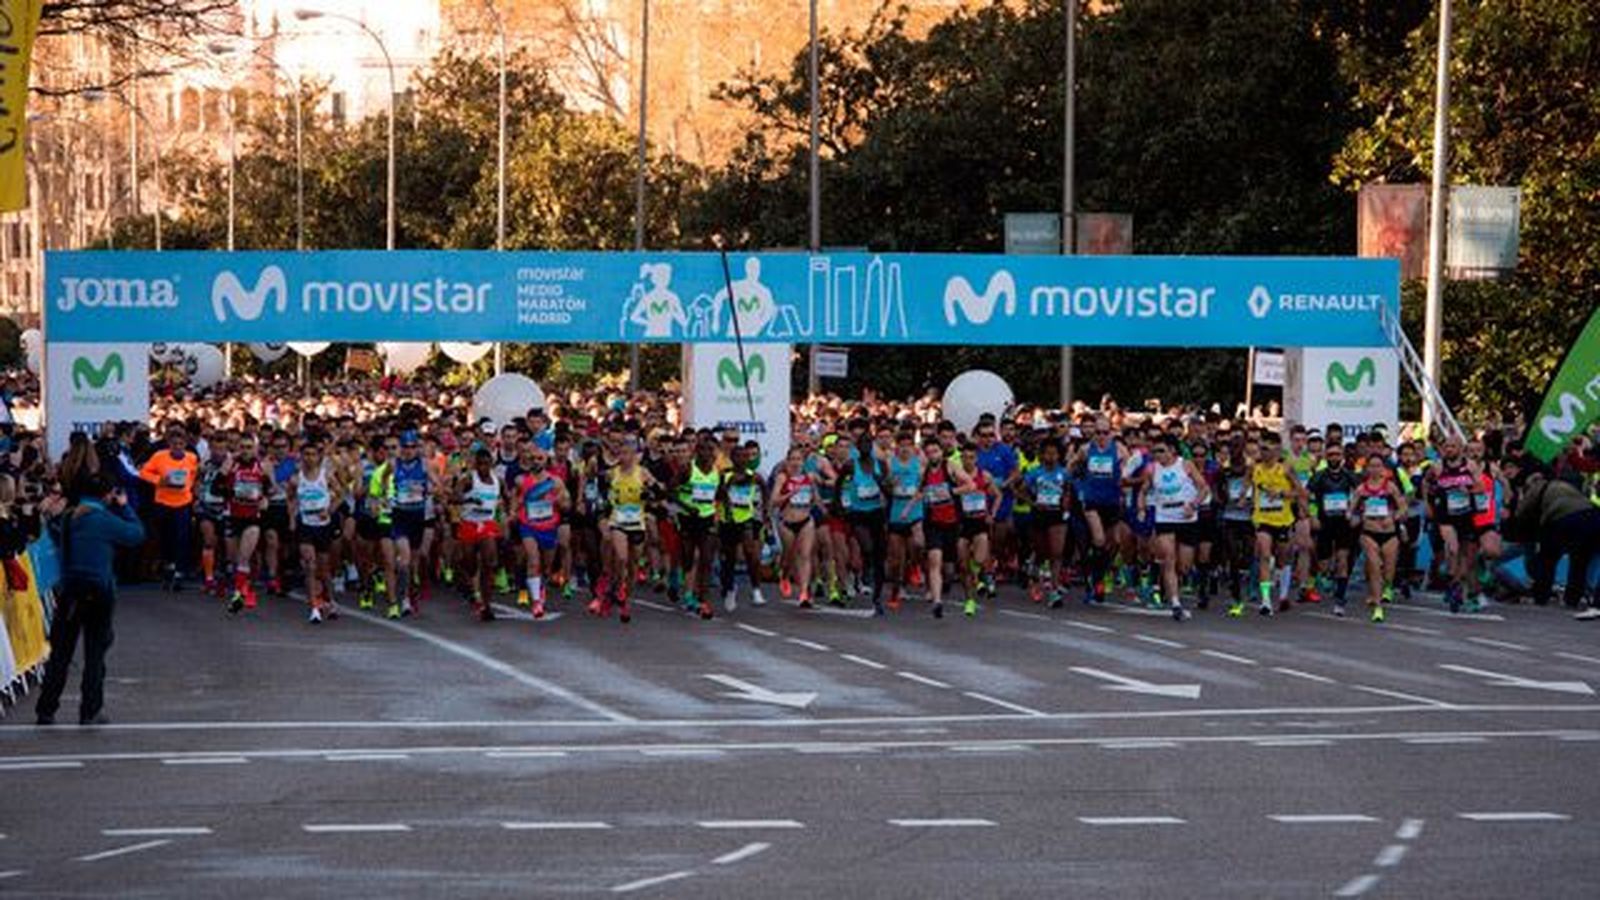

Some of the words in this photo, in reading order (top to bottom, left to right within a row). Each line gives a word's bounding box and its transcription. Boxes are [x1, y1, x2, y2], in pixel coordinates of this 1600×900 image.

[516, 267, 585, 281] movistar
[303, 278, 492, 313] movistar
[516, 284, 564, 296] MEDIO
[1030, 282, 1216, 318] movistar
[1279, 294, 1381, 311] RENAULT
[517, 312, 572, 324] MADRID
